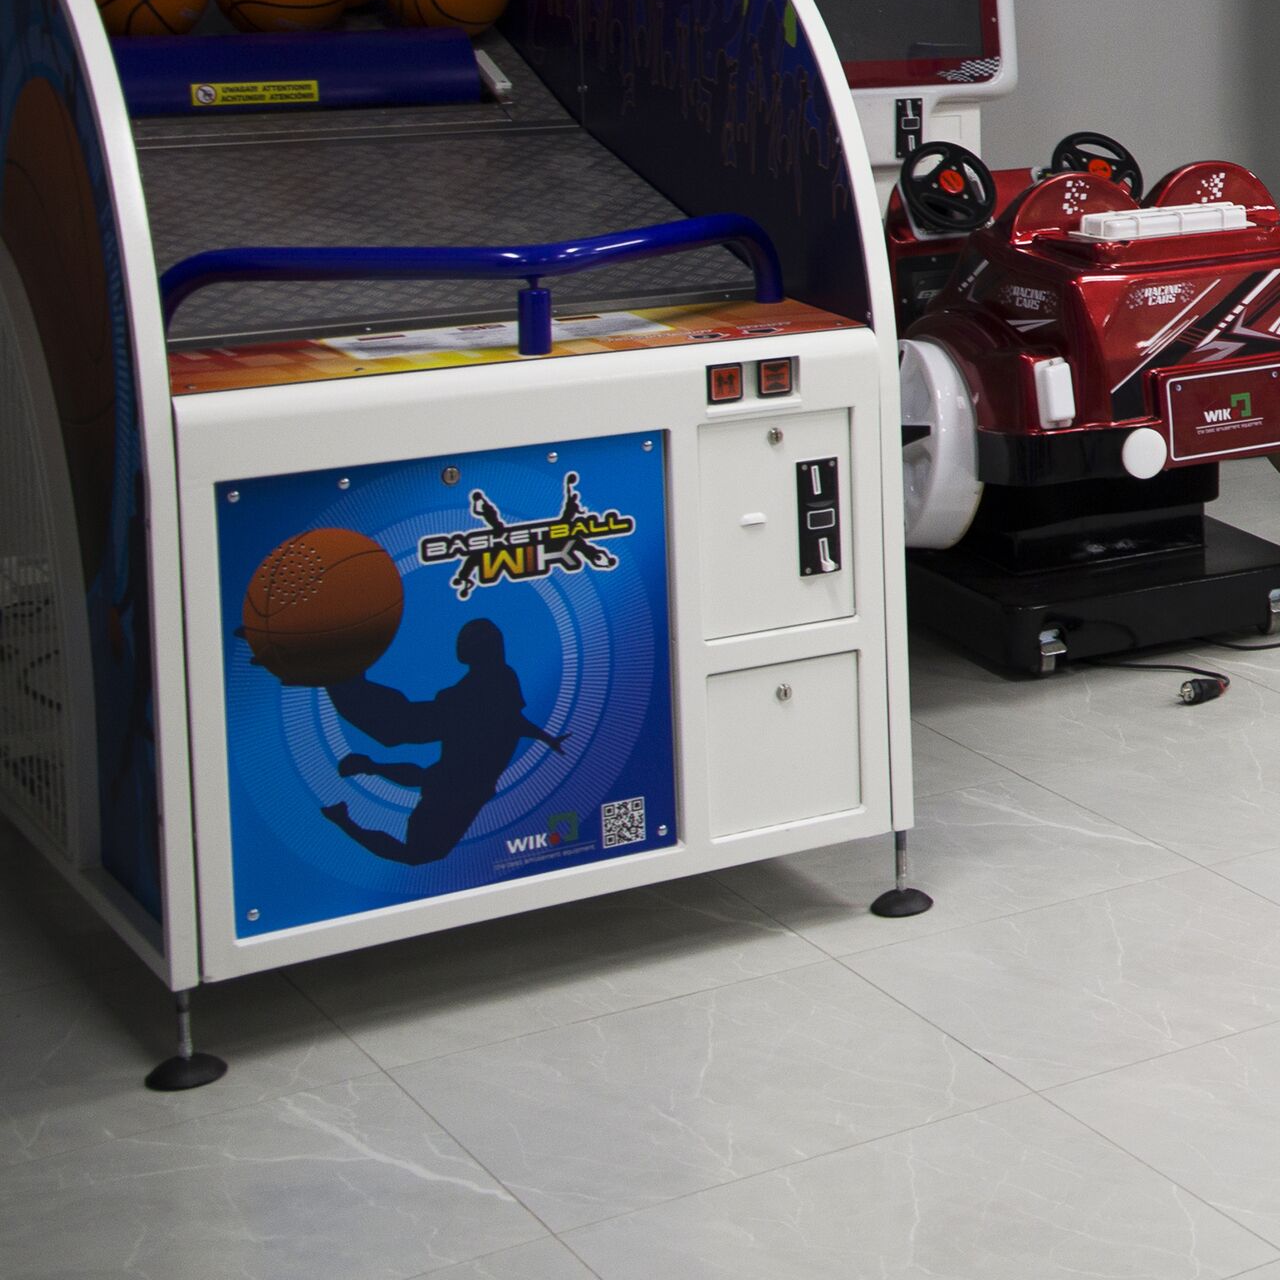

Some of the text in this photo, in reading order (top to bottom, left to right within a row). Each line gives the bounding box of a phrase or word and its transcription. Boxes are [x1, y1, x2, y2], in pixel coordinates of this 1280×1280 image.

[1144, 284, 1181, 297] RACING
[1204, 408, 1232, 423] WIK
[426, 516, 630, 557] BASKETBALL
[482, 539, 577, 580] WIK
[506, 832, 548, 854] WIK
